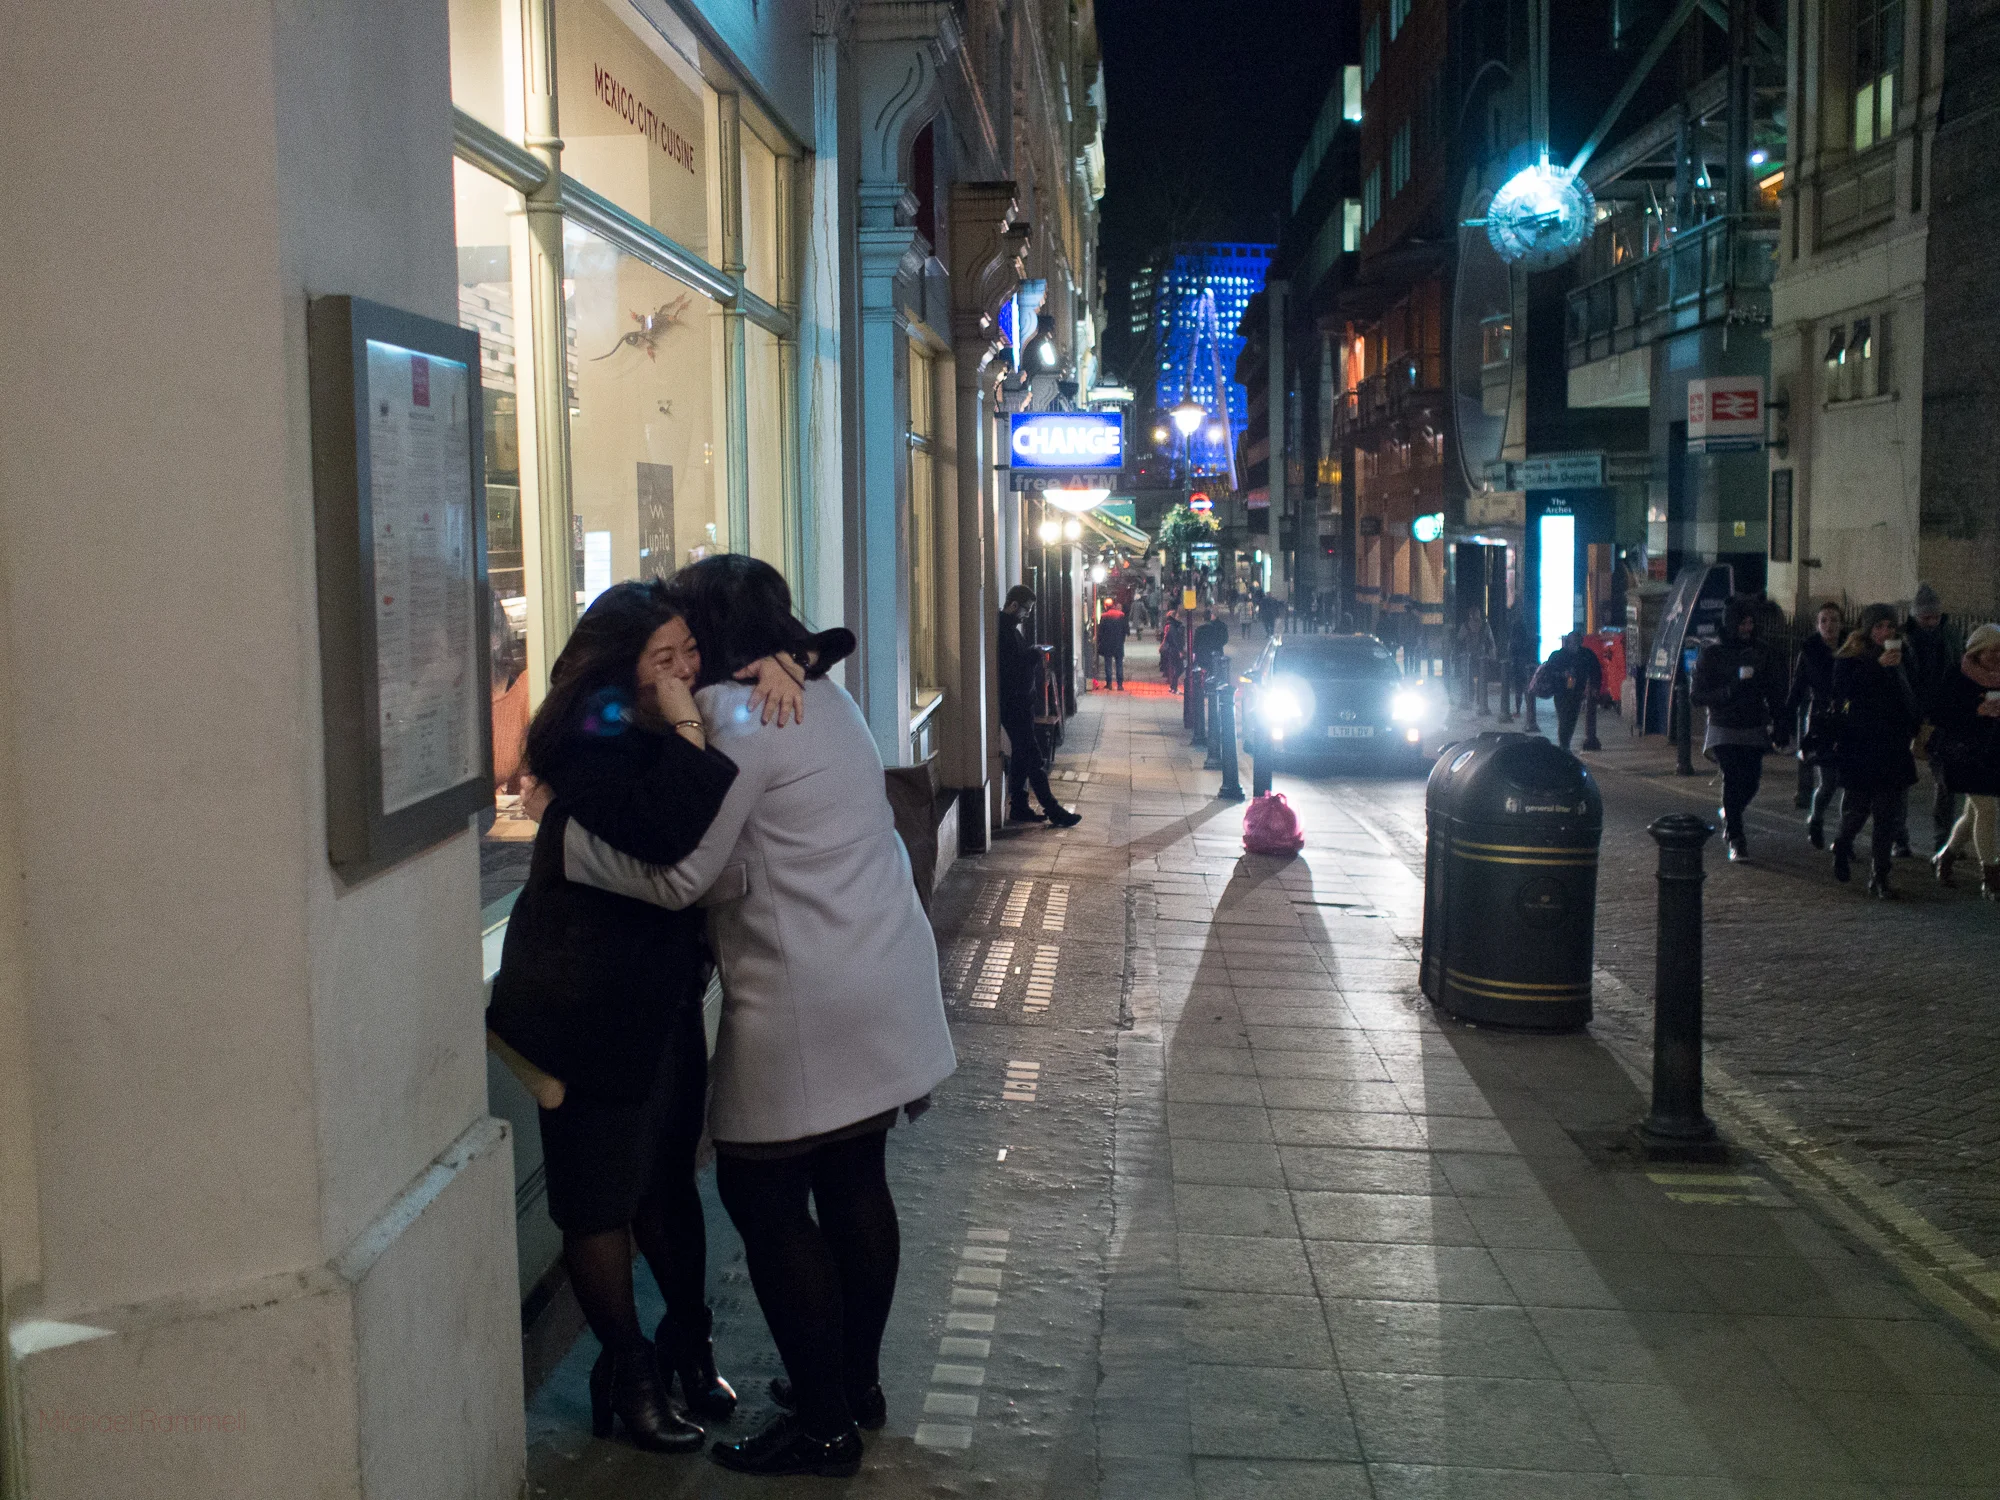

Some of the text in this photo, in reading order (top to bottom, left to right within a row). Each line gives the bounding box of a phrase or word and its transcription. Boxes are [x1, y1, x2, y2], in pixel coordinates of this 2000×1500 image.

[594, 63, 696, 175] MEXICO CITY CUISINE
[1012, 426, 1121, 455] CHANGE
[1015, 474, 1118, 491] free ATM
[1551, 498, 1566, 506] The
